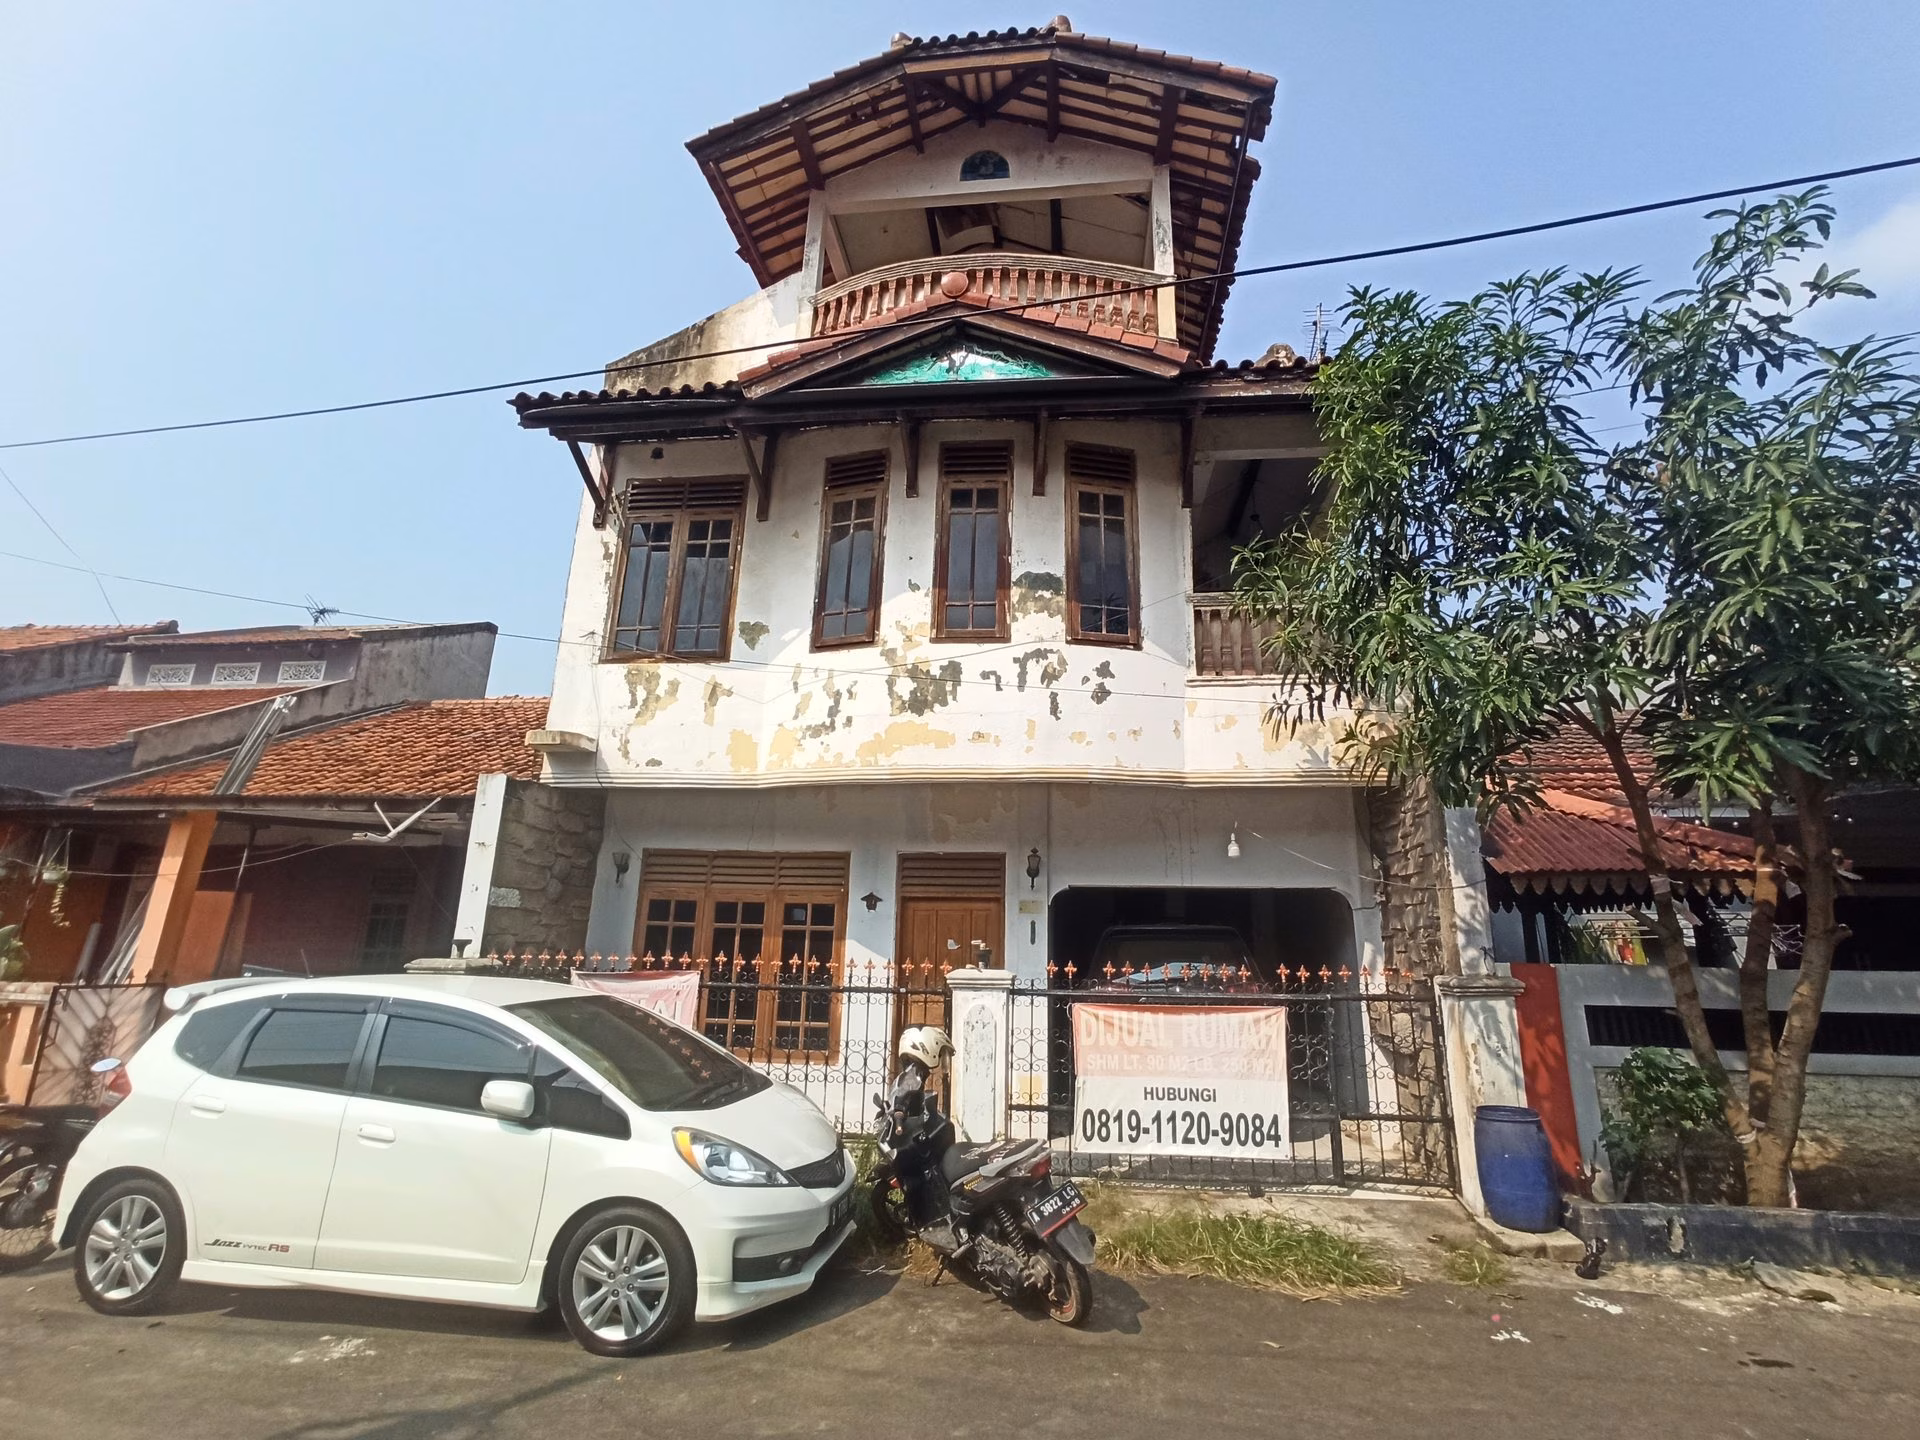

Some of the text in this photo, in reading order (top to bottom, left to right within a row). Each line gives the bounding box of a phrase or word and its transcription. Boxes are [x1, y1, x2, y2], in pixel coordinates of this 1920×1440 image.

[1080, 1011, 1278, 1051] DIJUAL RUMAH
[1087, 1054, 1119, 1071] SHM
[1147, 1055, 1164, 1071] 90
[1143, 1086, 1217, 1103] HUBUNGI
[1082, 1108, 1282, 1148] 0819-1120-9084
[1031, 1211, 1041, 1223] A
[268, 1243, 290, 1253] RS
